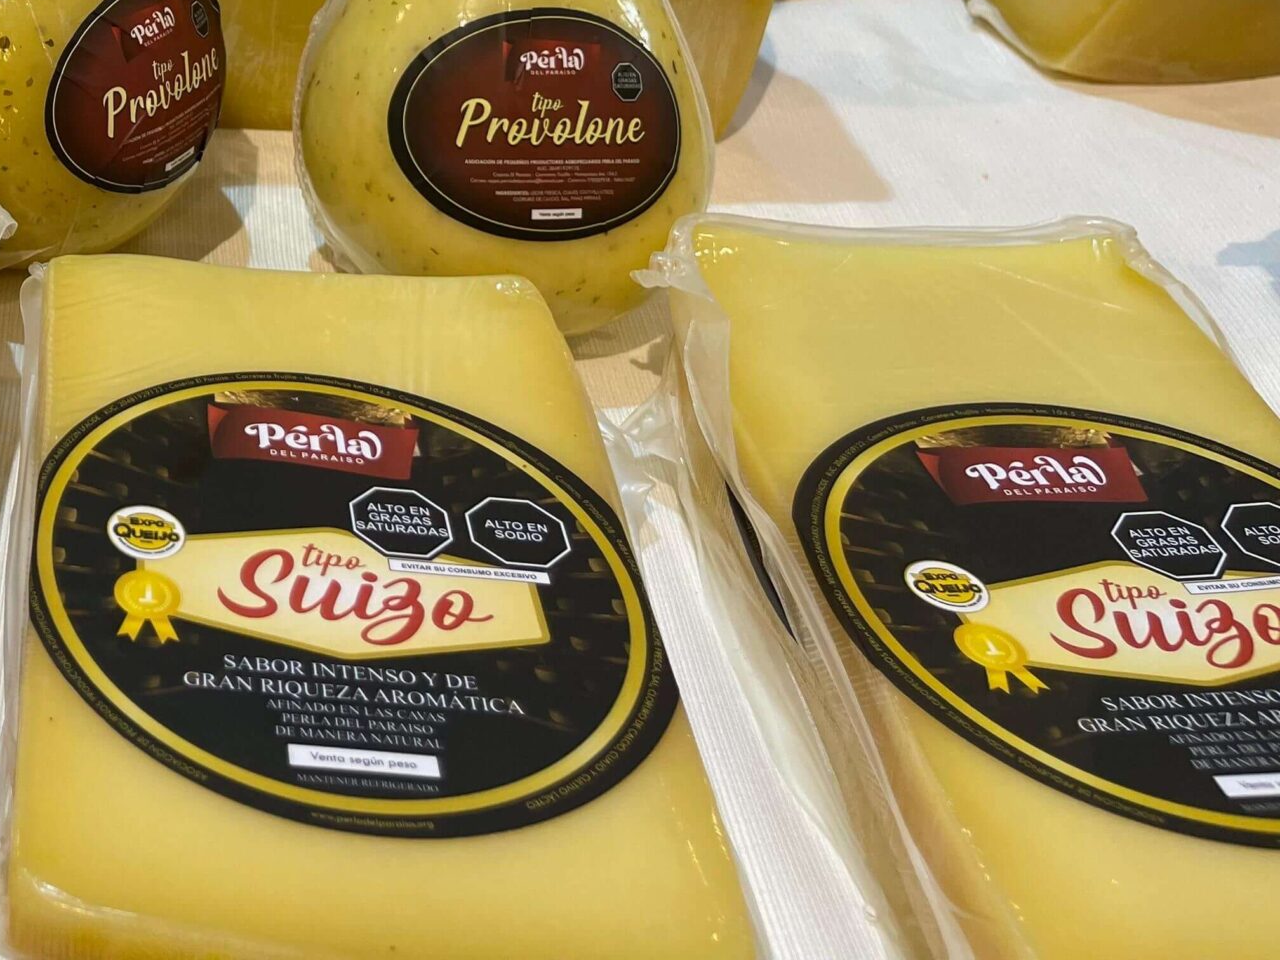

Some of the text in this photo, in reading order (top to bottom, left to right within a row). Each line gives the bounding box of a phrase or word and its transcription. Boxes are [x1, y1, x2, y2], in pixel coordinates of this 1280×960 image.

[152, 59, 175, 83] tipo
[103, 48, 219, 138] Provolone
[532, 92, 564, 118] tipo
[456, 98, 645, 148] Provolone
[270, 448, 364, 465] DEL PARAISO
[1003, 486, 1097, 496] DEL PARAISO
[367, 502, 431, 516] ALTO EN
[129, 517, 165, 527] EXPO
[369, 512, 432, 526] GRASAS
[484, 519, 548, 534] ALTO EN
[113, 523, 179, 542] QUEIJO
[356, 520, 449, 537] SATURADAS
[495, 529, 543, 542] SODIO
[1129, 526, 1190, 538] ALTO EN
[1244, 526, 1280, 536] ALTO
[1136, 536, 1199, 547] GRASAS
[302, 543, 366, 576] tipo
[1130, 544, 1220, 558] SATURADAS
[218, 548, 494, 646] Suizo
[1099, 579, 1166, 609] tipo
[223, 654, 478, 690] SABOR INTENSO Y DE
[183, 671, 524, 715] GRAN RIQUEZA AROMÁTICA
[1101, 694, 1183, 712] SABOR
[1077, 712, 1256, 733] GRAN RIQUEZA
[310, 751, 417, 770] Venta según peso
